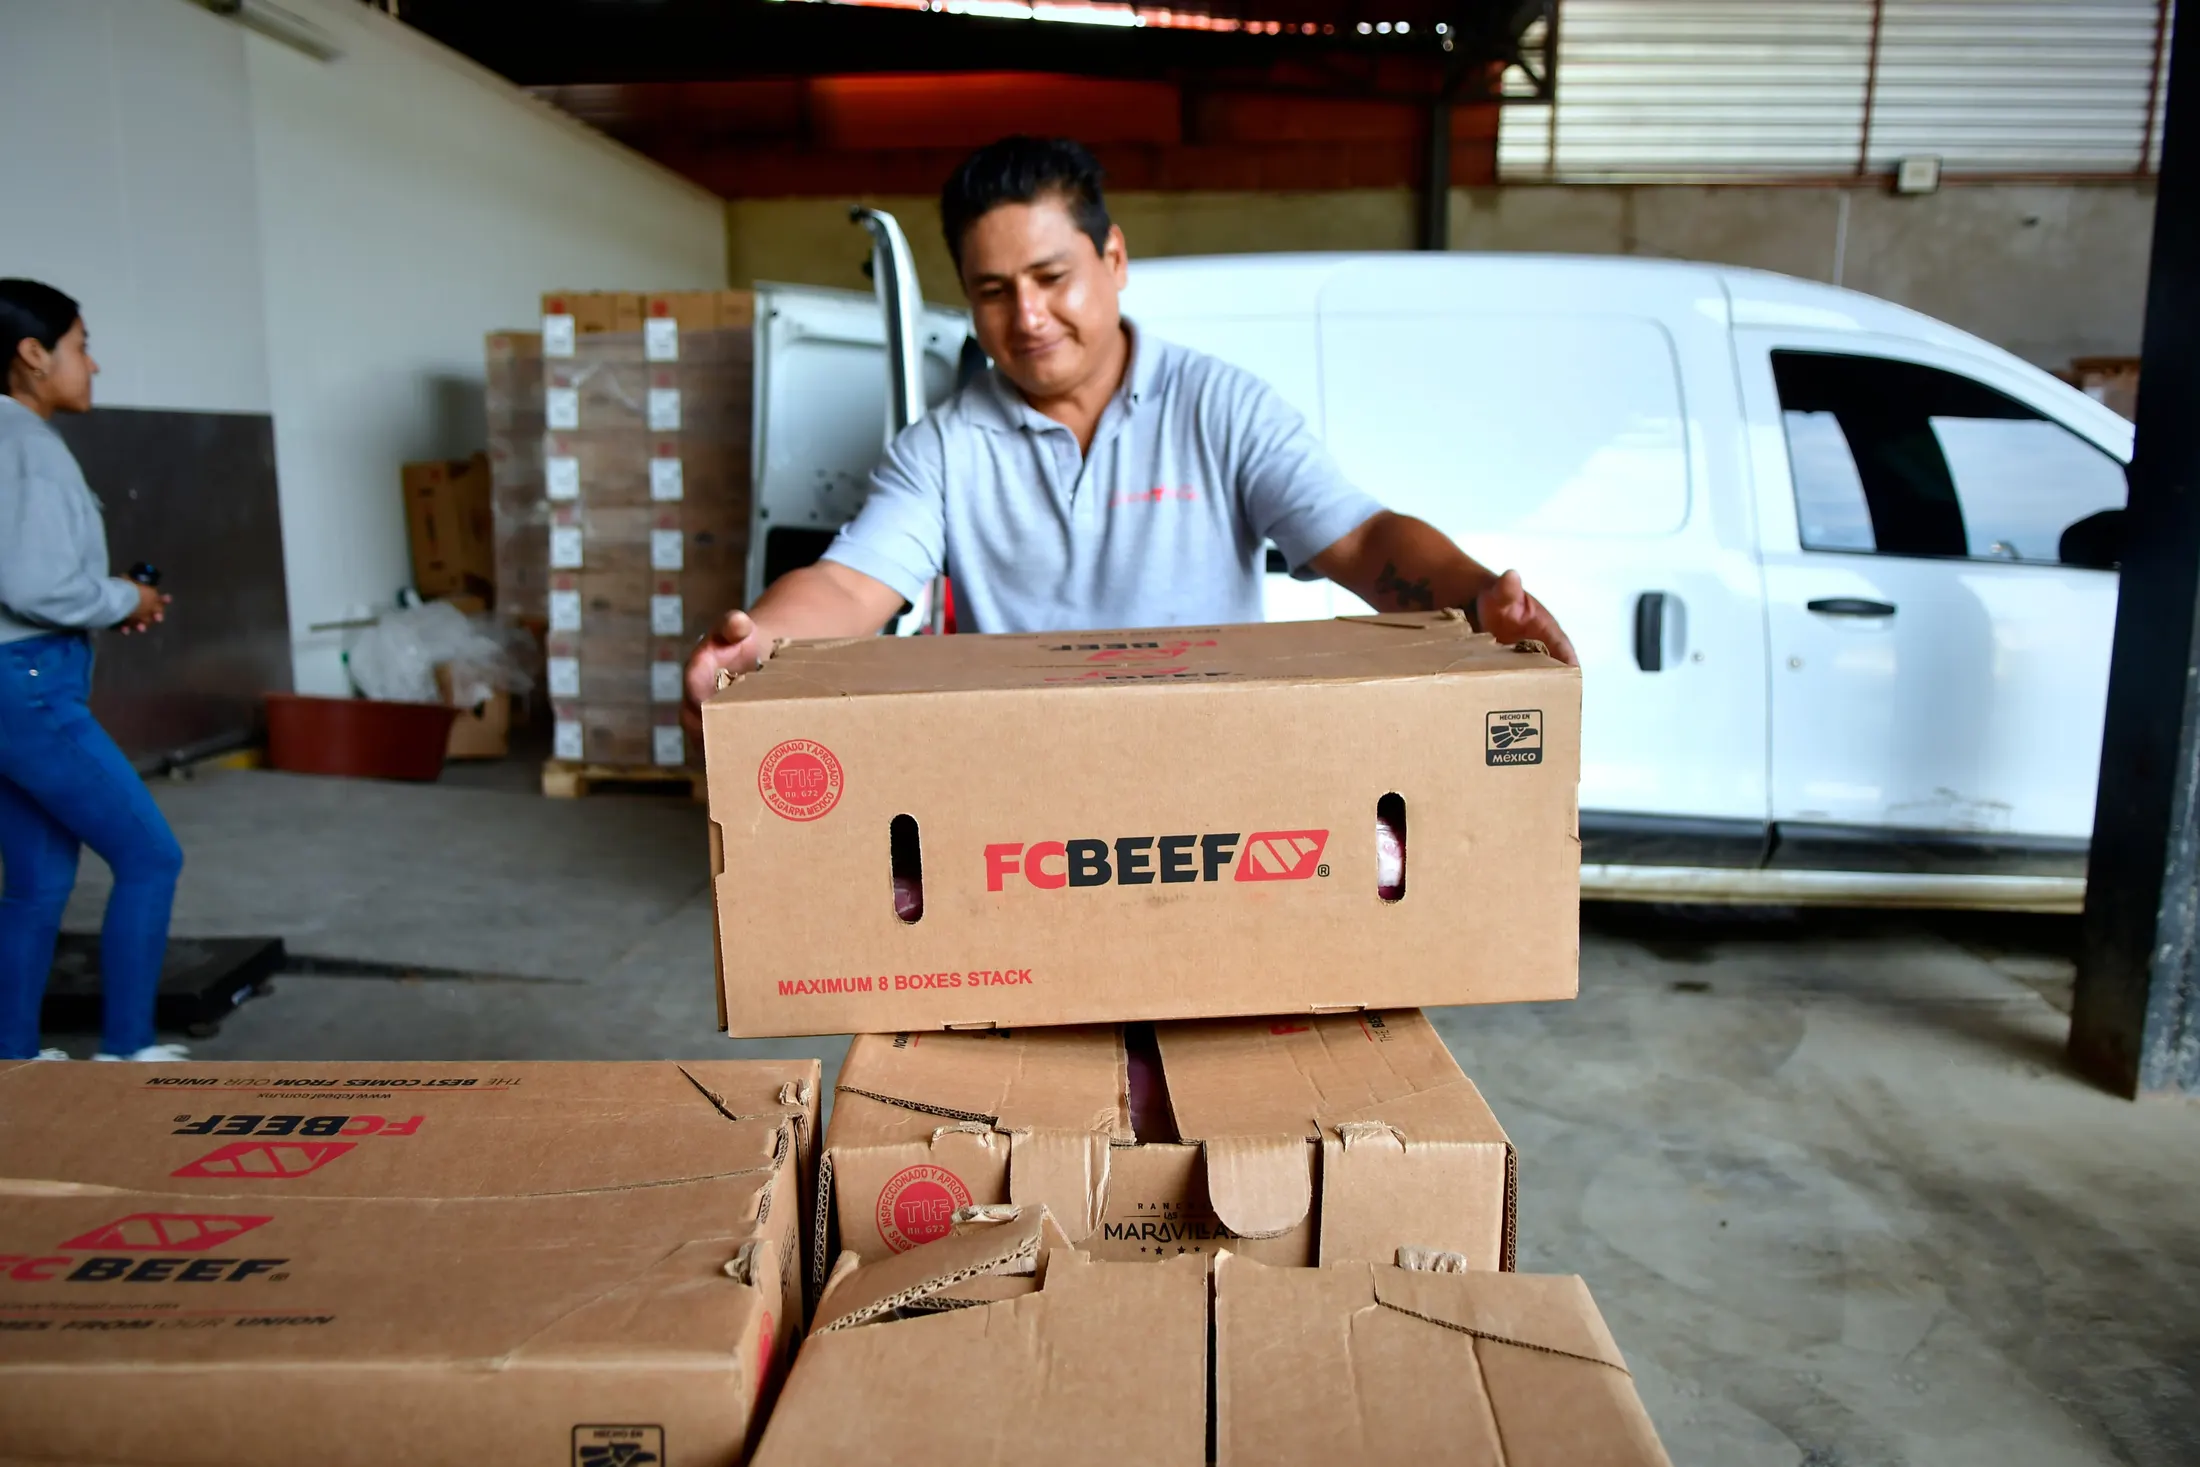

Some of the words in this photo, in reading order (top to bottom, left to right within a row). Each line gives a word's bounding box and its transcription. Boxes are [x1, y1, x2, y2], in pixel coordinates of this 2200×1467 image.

[762, 742, 805, 791] INSPECCIONADO
[806, 743, 812, 751] Y
[811, 747, 839, 787] APROBADO
[779, 768, 824, 788] TIF
[801, 789, 819, 797] 672
[768, 793, 806, 817] SAGARPA
[806, 791, 835, 815] MEXICO
[778, 976, 873, 996] MAXIMUM
[878, 976, 889, 991] 8
[894, 972, 962, 990] BOXES
[967, 969, 1033, 987] STACK
[145, 1077, 219, 1086] UNION
[223, 1078, 271, 1087] OUR
[272, 1079, 340, 1087] FROM
[343, 1079, 421, 1087] COMES
[422, 1079, 479, 1087] BEST
[487, 1078, 522, 1086] THE
[881, 1168, 929, 1228] INSPECCIONADO
[931, 1169, 938, 1179] Y
[937, 1173, 968, 1208] APROBA
[900, 1199, 951, 1223] TIF
[1164, 1211, 1178, 1220] LAS
[925, 1224, 946, 1234] 672
